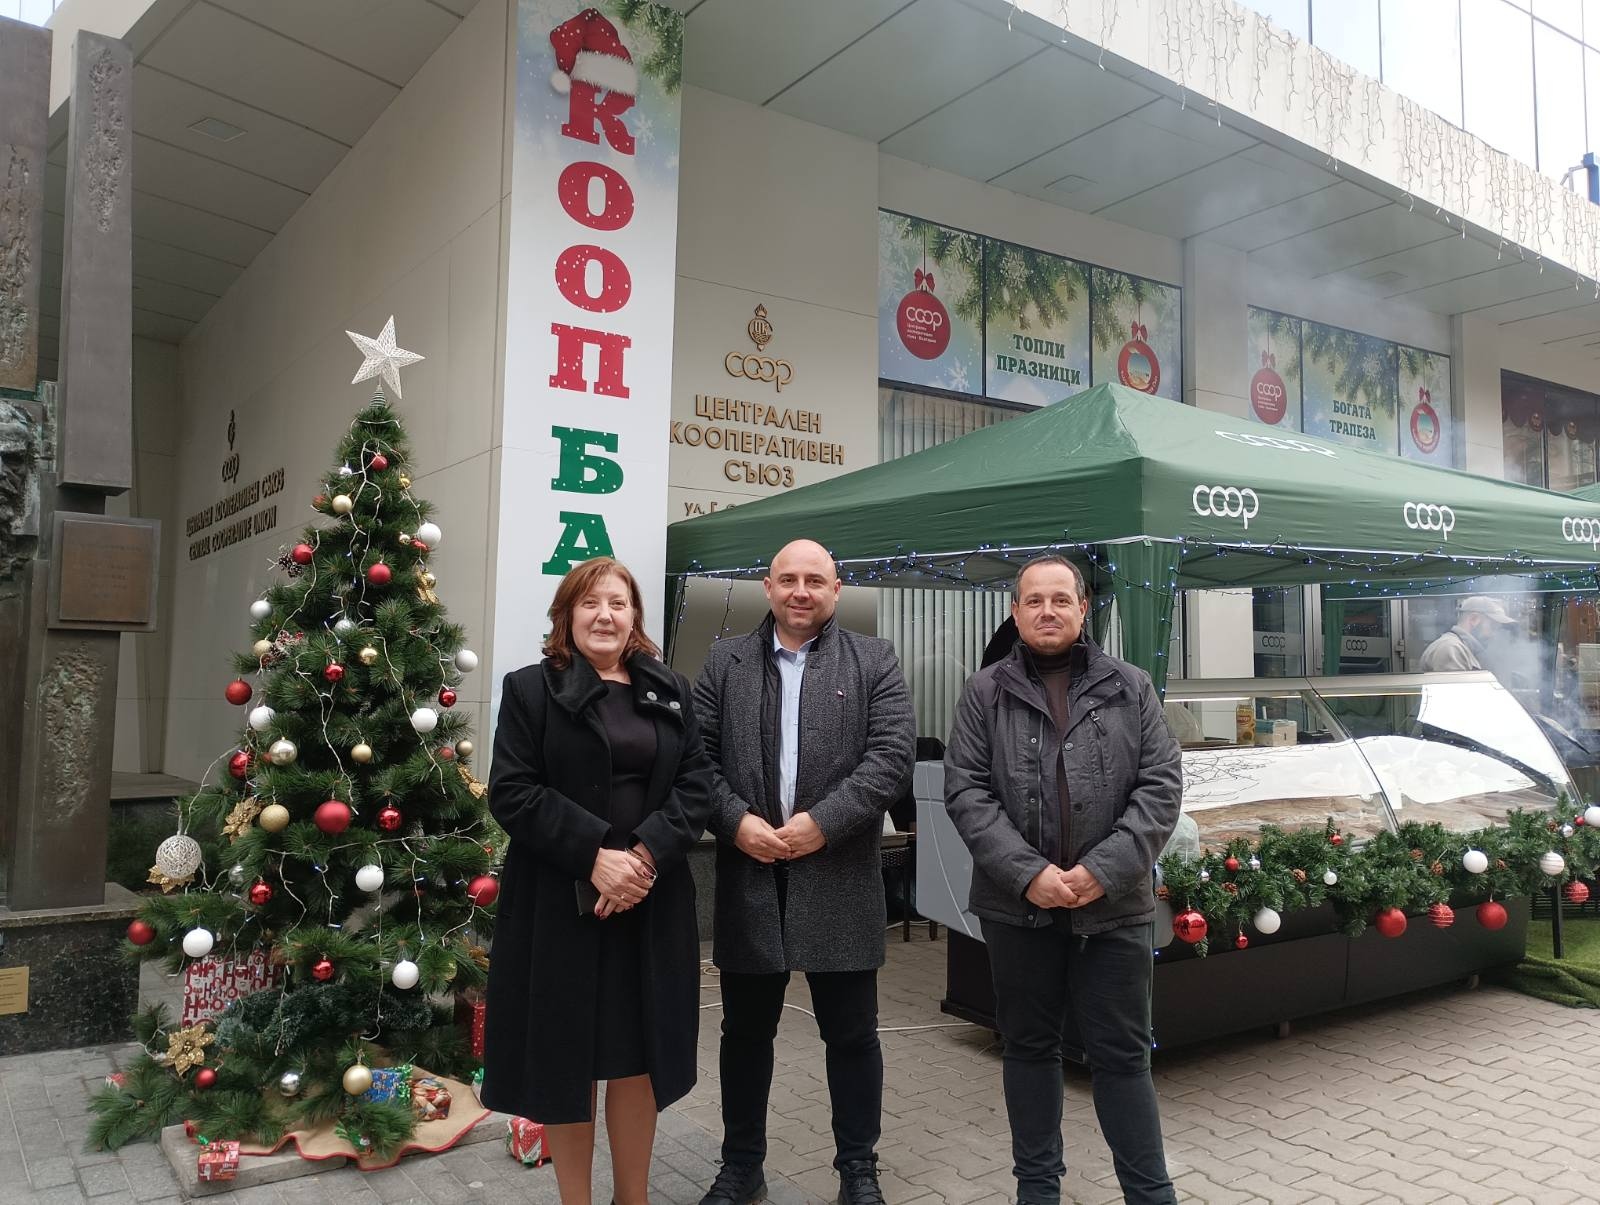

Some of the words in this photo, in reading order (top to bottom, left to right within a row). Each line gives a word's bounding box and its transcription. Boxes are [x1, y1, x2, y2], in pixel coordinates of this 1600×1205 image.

[548, 80, 637, 400] КООП
[905, 306, 943, 332] coop
[1013, 333, 1066, 360] ТОПЛИ
[725, 351, 795, 393] coop
[997, 354, 1081, 386] ПРАЗНИЦИ
[695, 394, 822, 434] ЦЕНТРАЛЕН
[1333, 400, 1372, 420] БОГАТА
[670, 420, 846, 466] КООПЕРАТИВЕН
[1329, 419, 1377, 441] ТРАПЕЗА
[724, 459, 796, 488] СЪЮЗ
[1192, 484, 1259, 530] coop
[1403, 502, 1455, 542] coop
